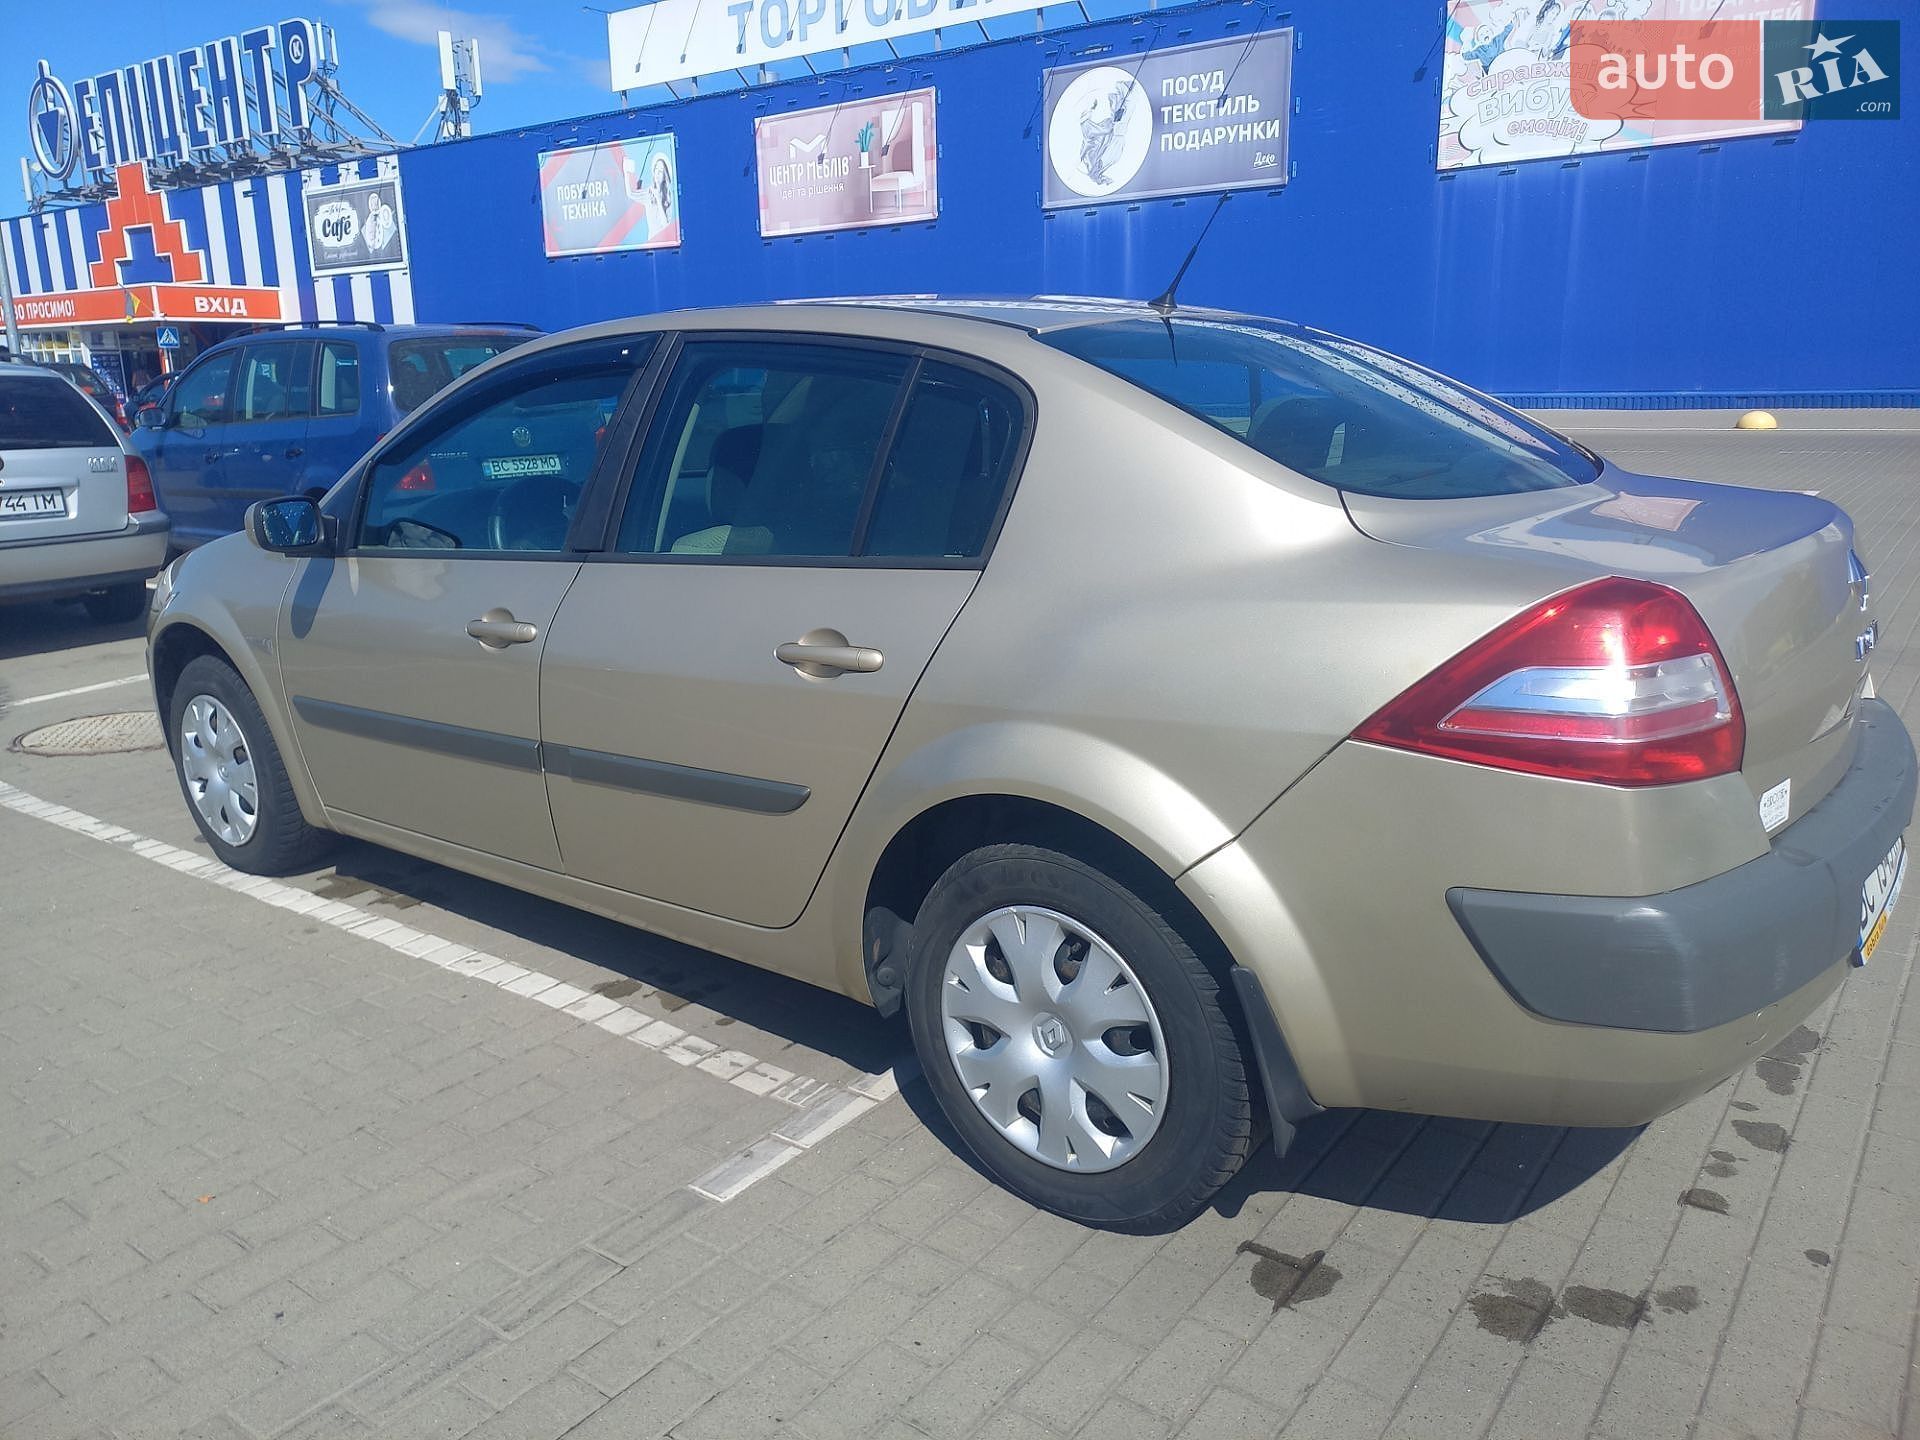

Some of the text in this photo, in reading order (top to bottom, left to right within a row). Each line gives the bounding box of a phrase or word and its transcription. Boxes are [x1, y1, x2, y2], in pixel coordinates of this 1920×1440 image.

[73, 17, 317, 172] ЕПІЦЕНТР
[1161, 69, 1226, 98] ПОСУД
[1160, 94, 1261, 125] ТЕКСТИЛЬ
[1160, 119, 1280, 152] ПОДАРУНКИ
[769, 156, 850, 186] ЦЕНТР МЕБЛІВ
[808, 181, 845, 198] рішення
[562, 200, 608, 220] ТЕХНІКА
[322, 214, 352, 242] Café
[25, 299, 76, 321] ПРОСИМО!
[193, 295, 249, 317] ВХІД
[491, 455, 558, 473] BC 5528 MO
[0, 495, 27, 512] 44
